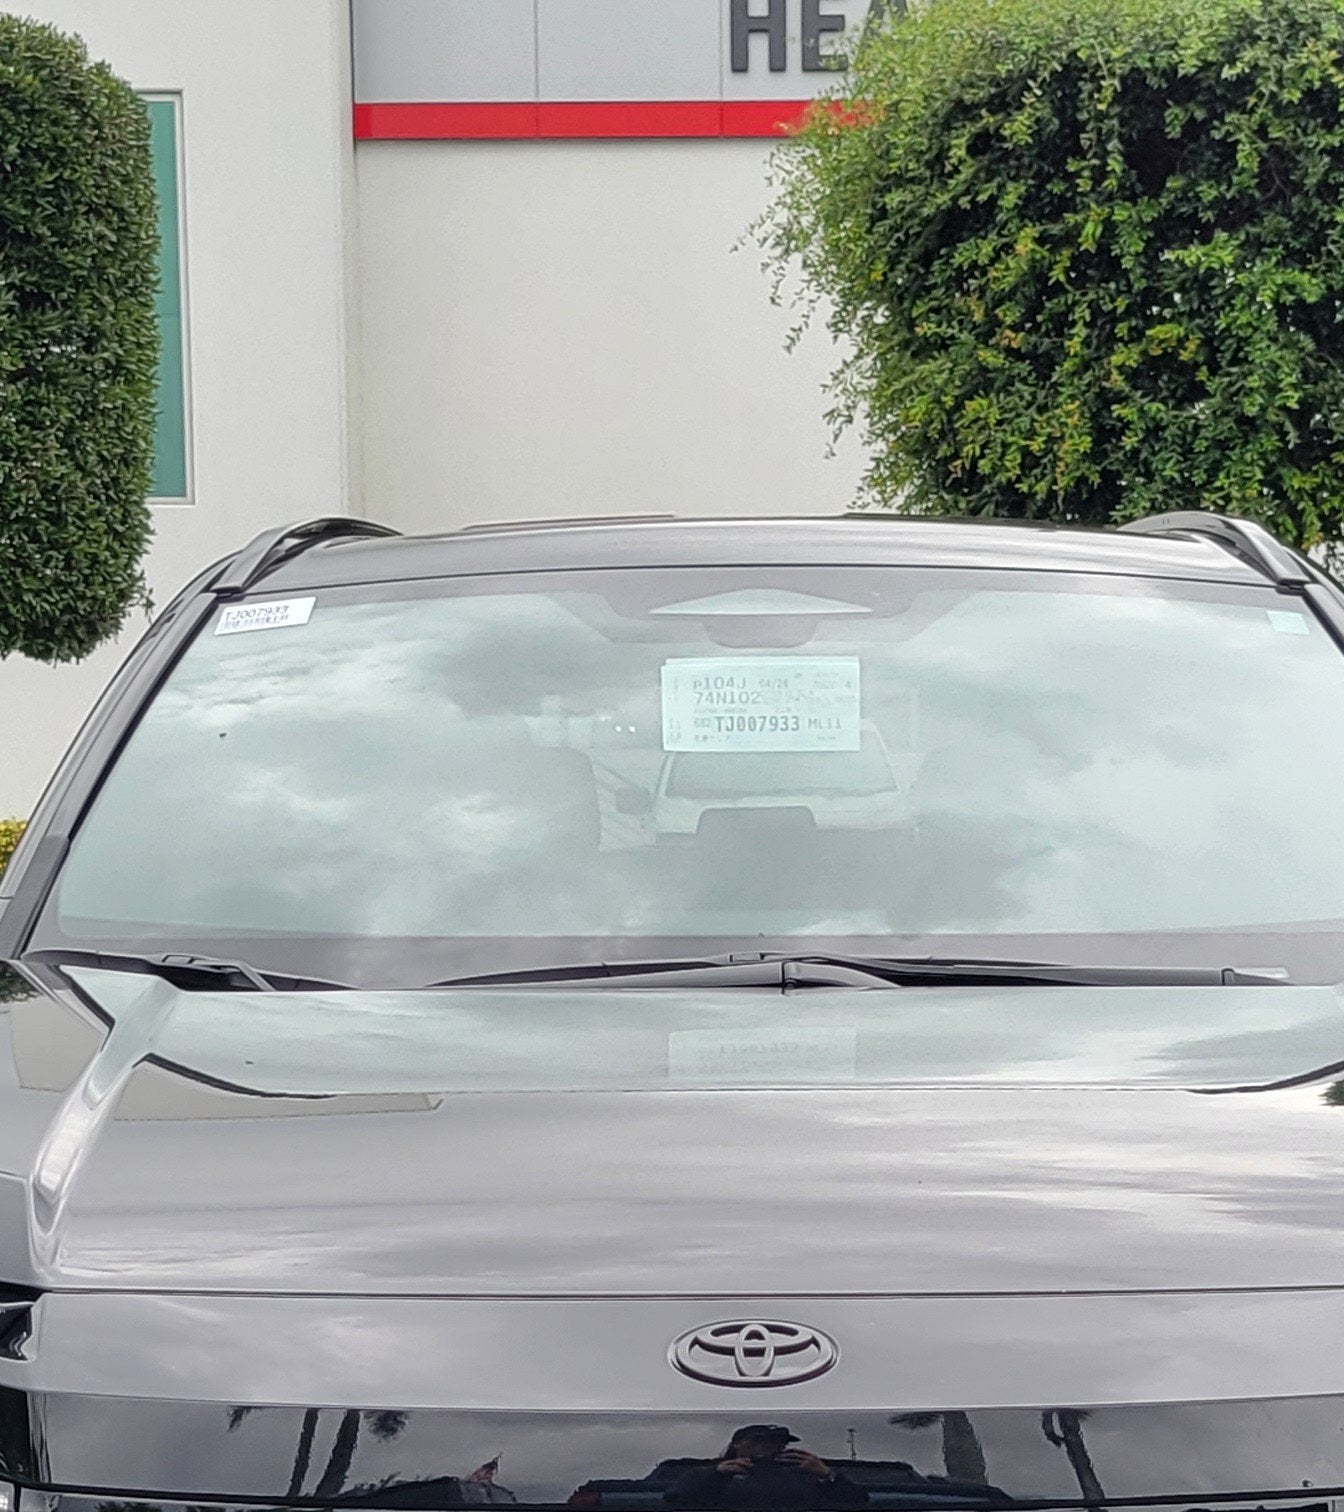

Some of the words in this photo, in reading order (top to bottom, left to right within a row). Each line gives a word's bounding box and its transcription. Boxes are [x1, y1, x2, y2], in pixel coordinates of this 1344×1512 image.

[225, 605, 290, 622] TJ007933
[693, 690, 762, 705] 74N102
[714, 715, 801, 732] TJ007933
